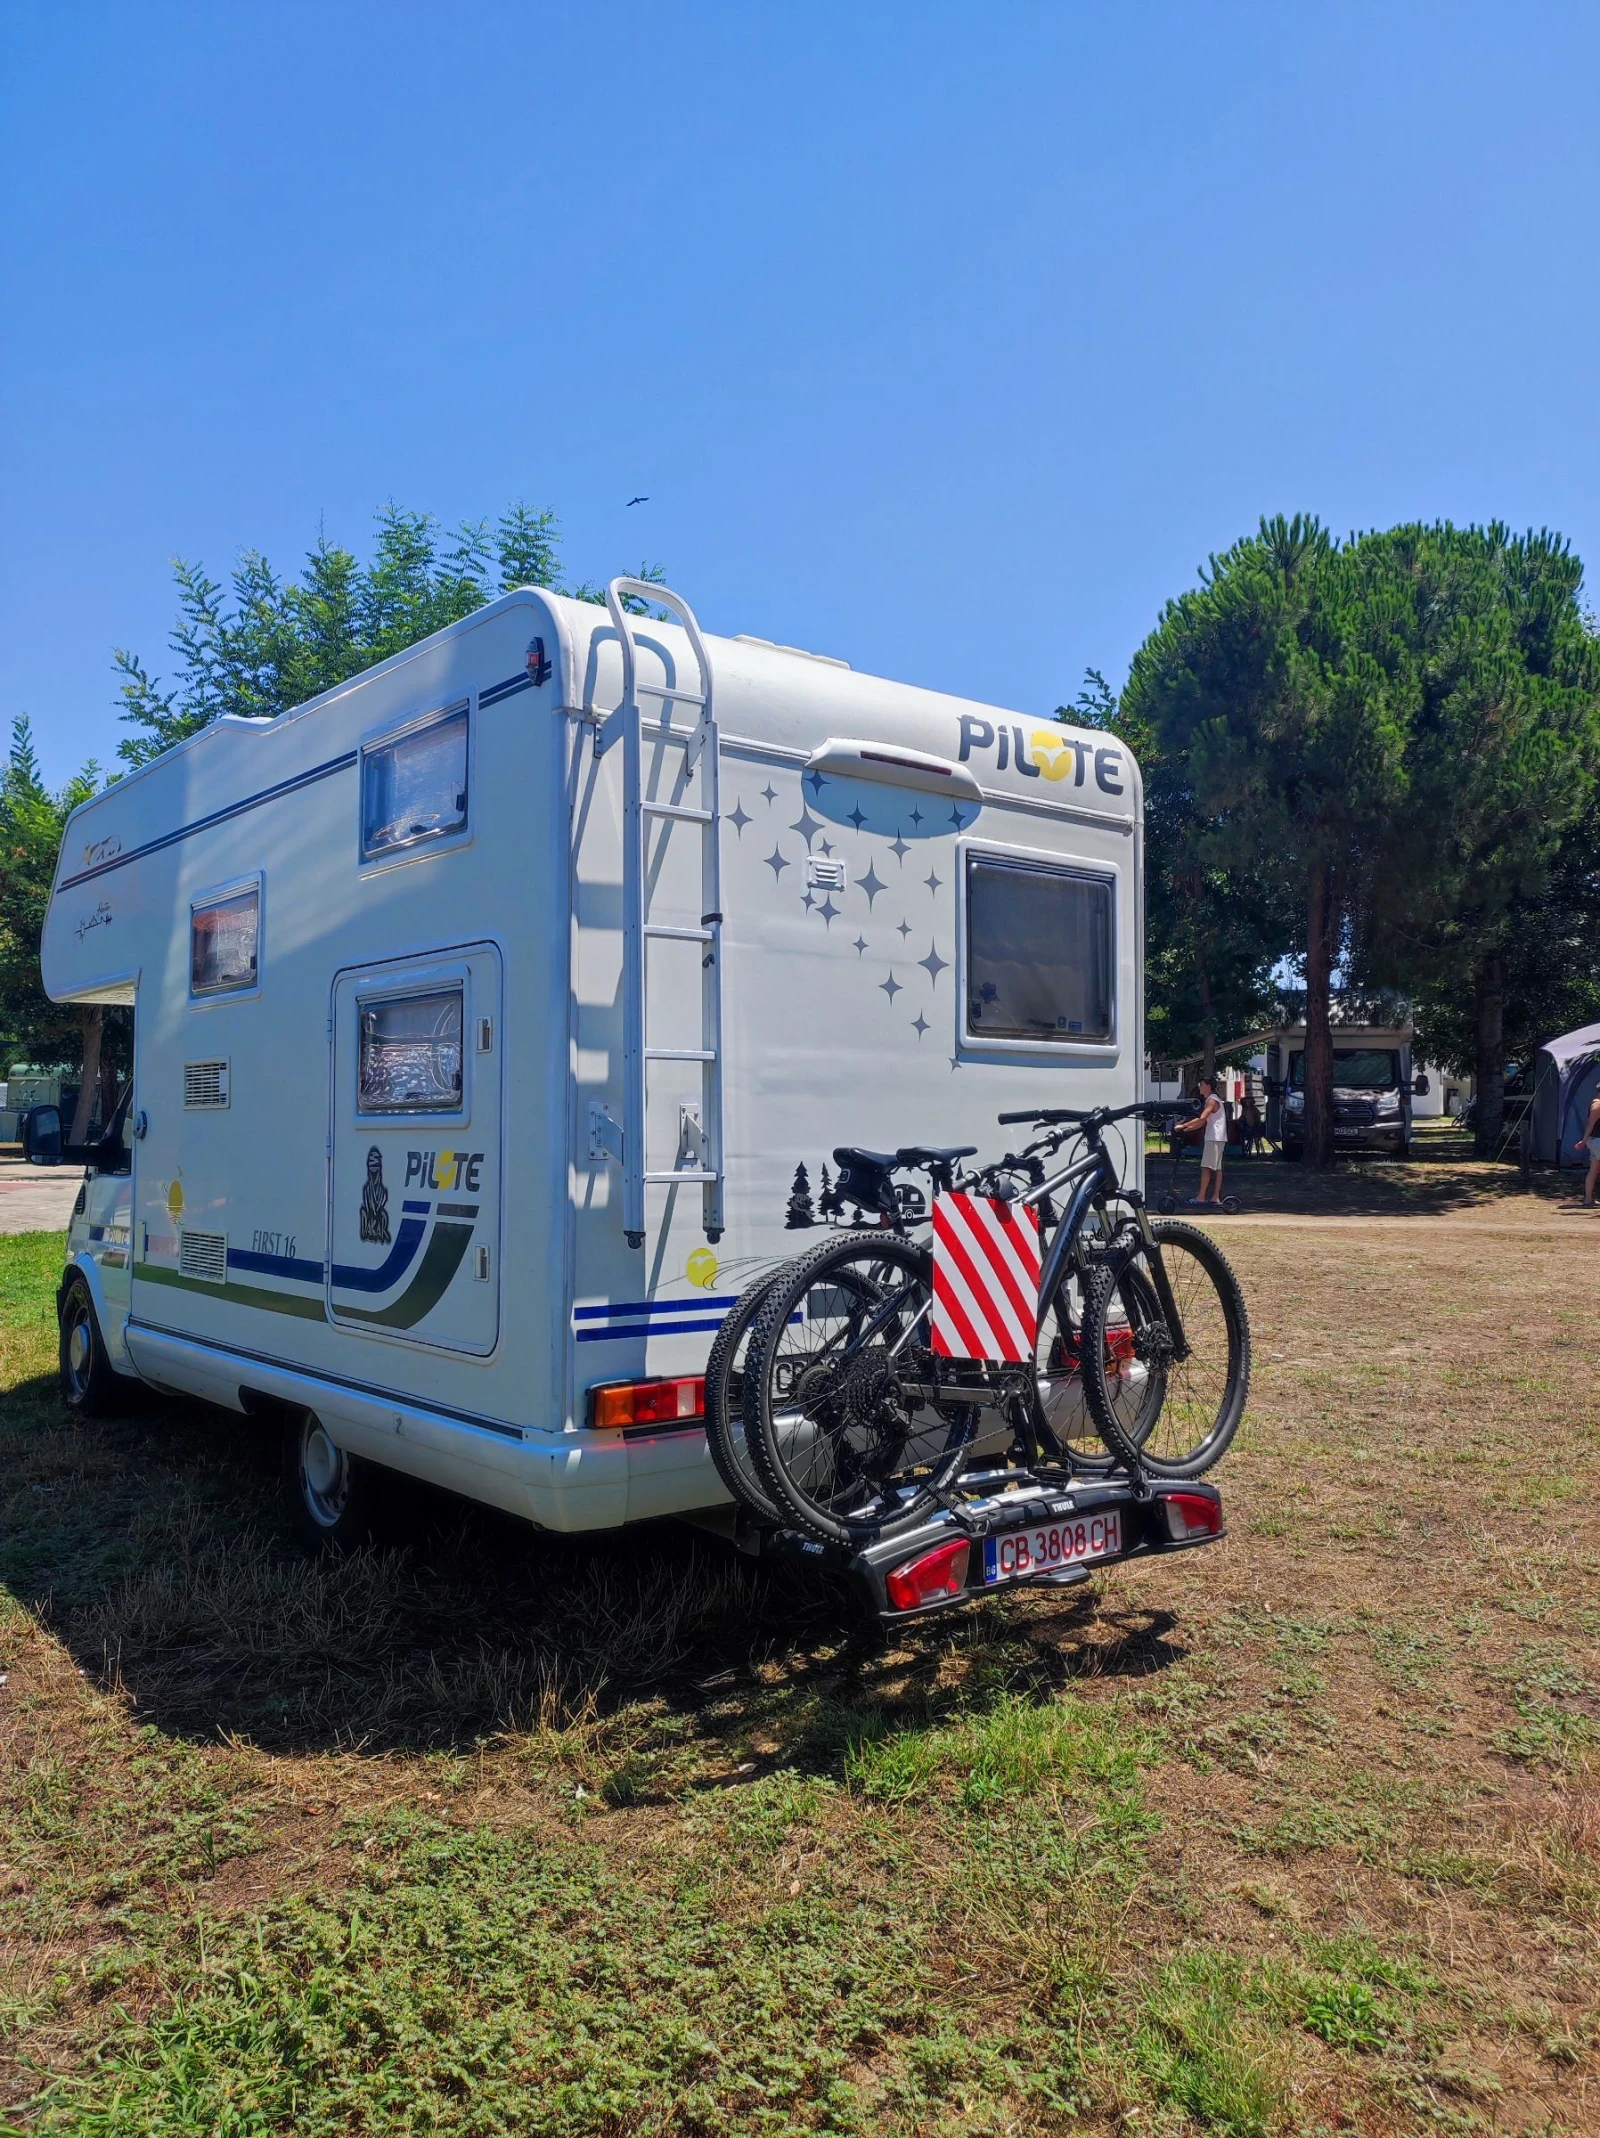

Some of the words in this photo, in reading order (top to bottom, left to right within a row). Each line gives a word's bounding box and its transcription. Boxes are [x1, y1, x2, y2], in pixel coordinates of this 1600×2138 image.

[360, 1206, 391, 1245] DAKAR
[252, 1230, 282, 1256] FIRST
[285, 1236, 296, 1259] 16
[1051, 1500, 1075, 1513] THULE
[802, 1542, 825, 1554] THULE
[1000, 1536, 1030, 1574] CB
[1034, 1523, 1087, 1564] 3808
[1090, 1516, 1118, 1552] CH
[985, 1565, 996, 1577] BG
